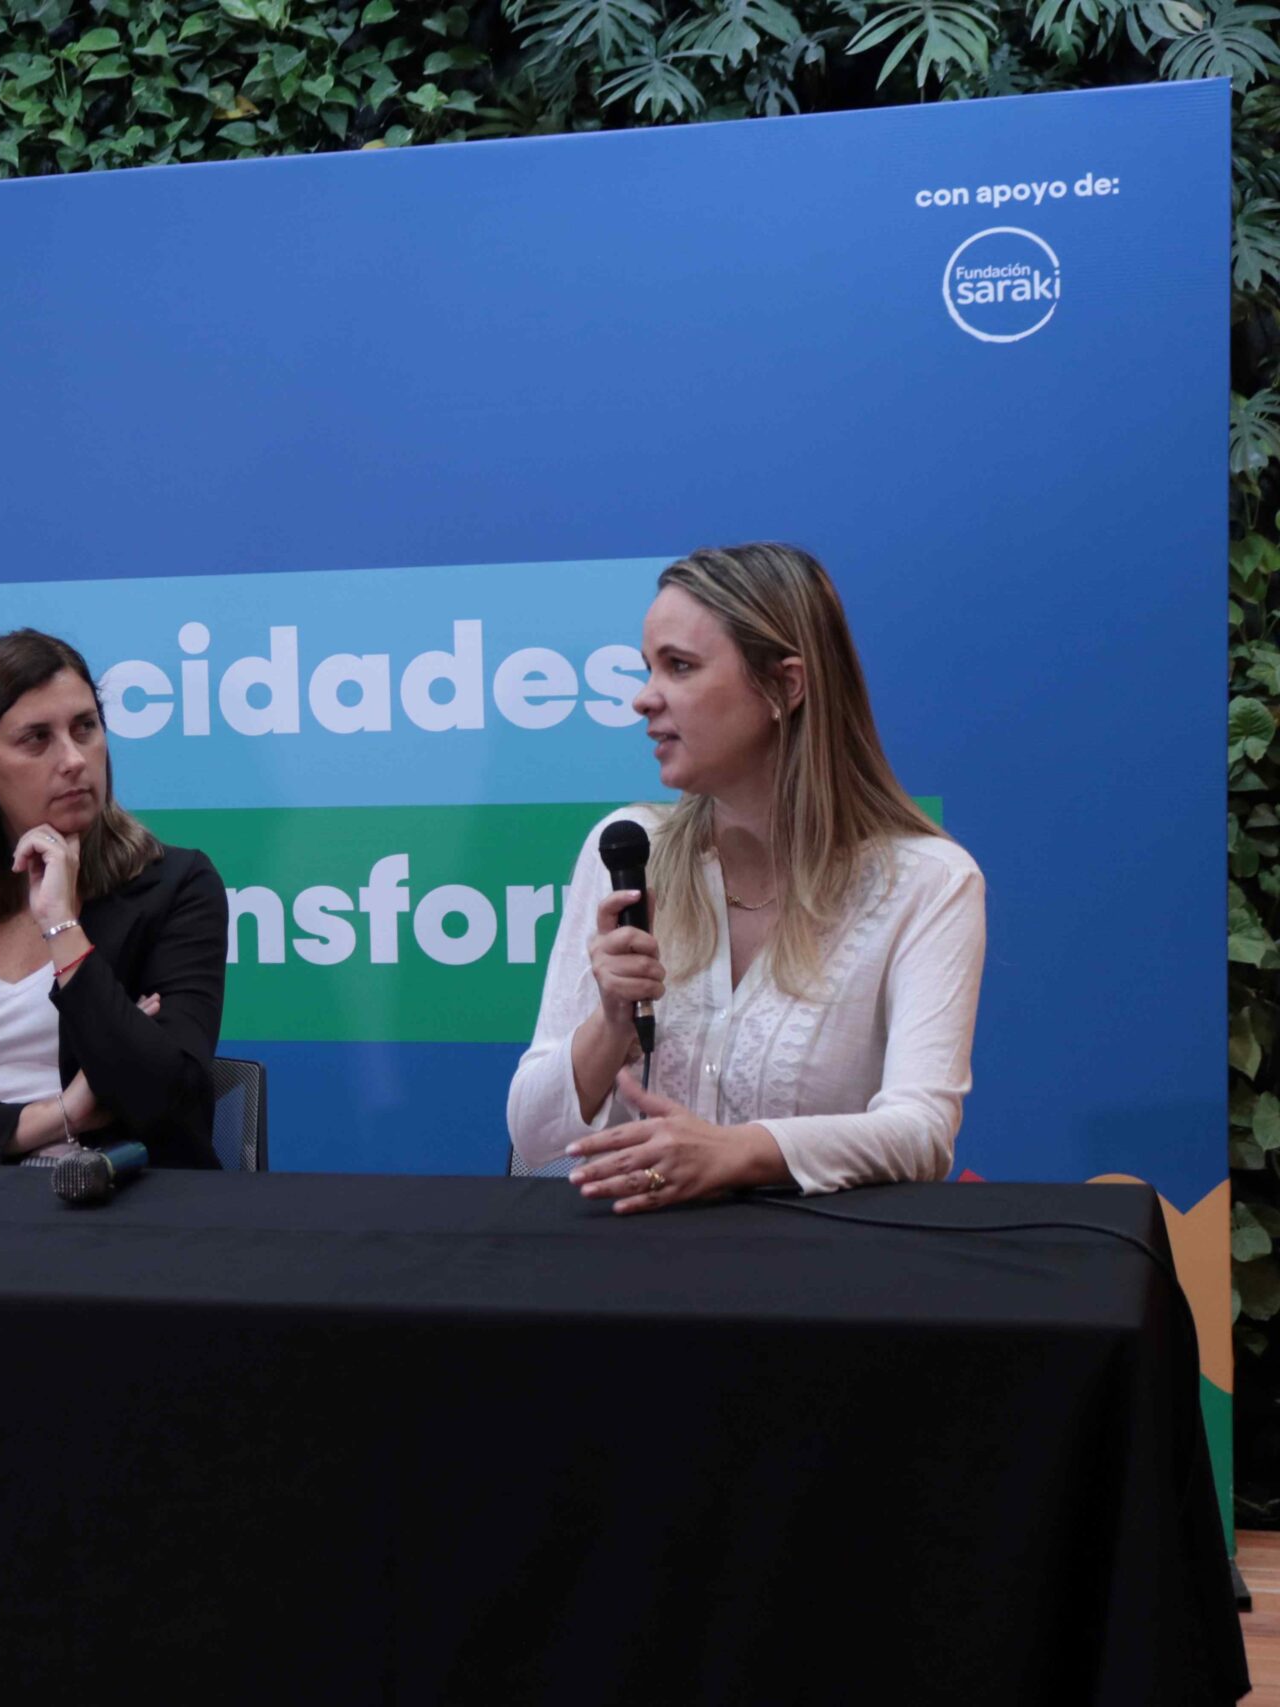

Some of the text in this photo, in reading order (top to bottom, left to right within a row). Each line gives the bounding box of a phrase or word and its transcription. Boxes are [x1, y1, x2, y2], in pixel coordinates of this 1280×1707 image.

[915, 172, 1120, 208] con apoyo de:
[955, 262, 1031, 281] Fundación
[956, 269, 1061, 305] saraki
